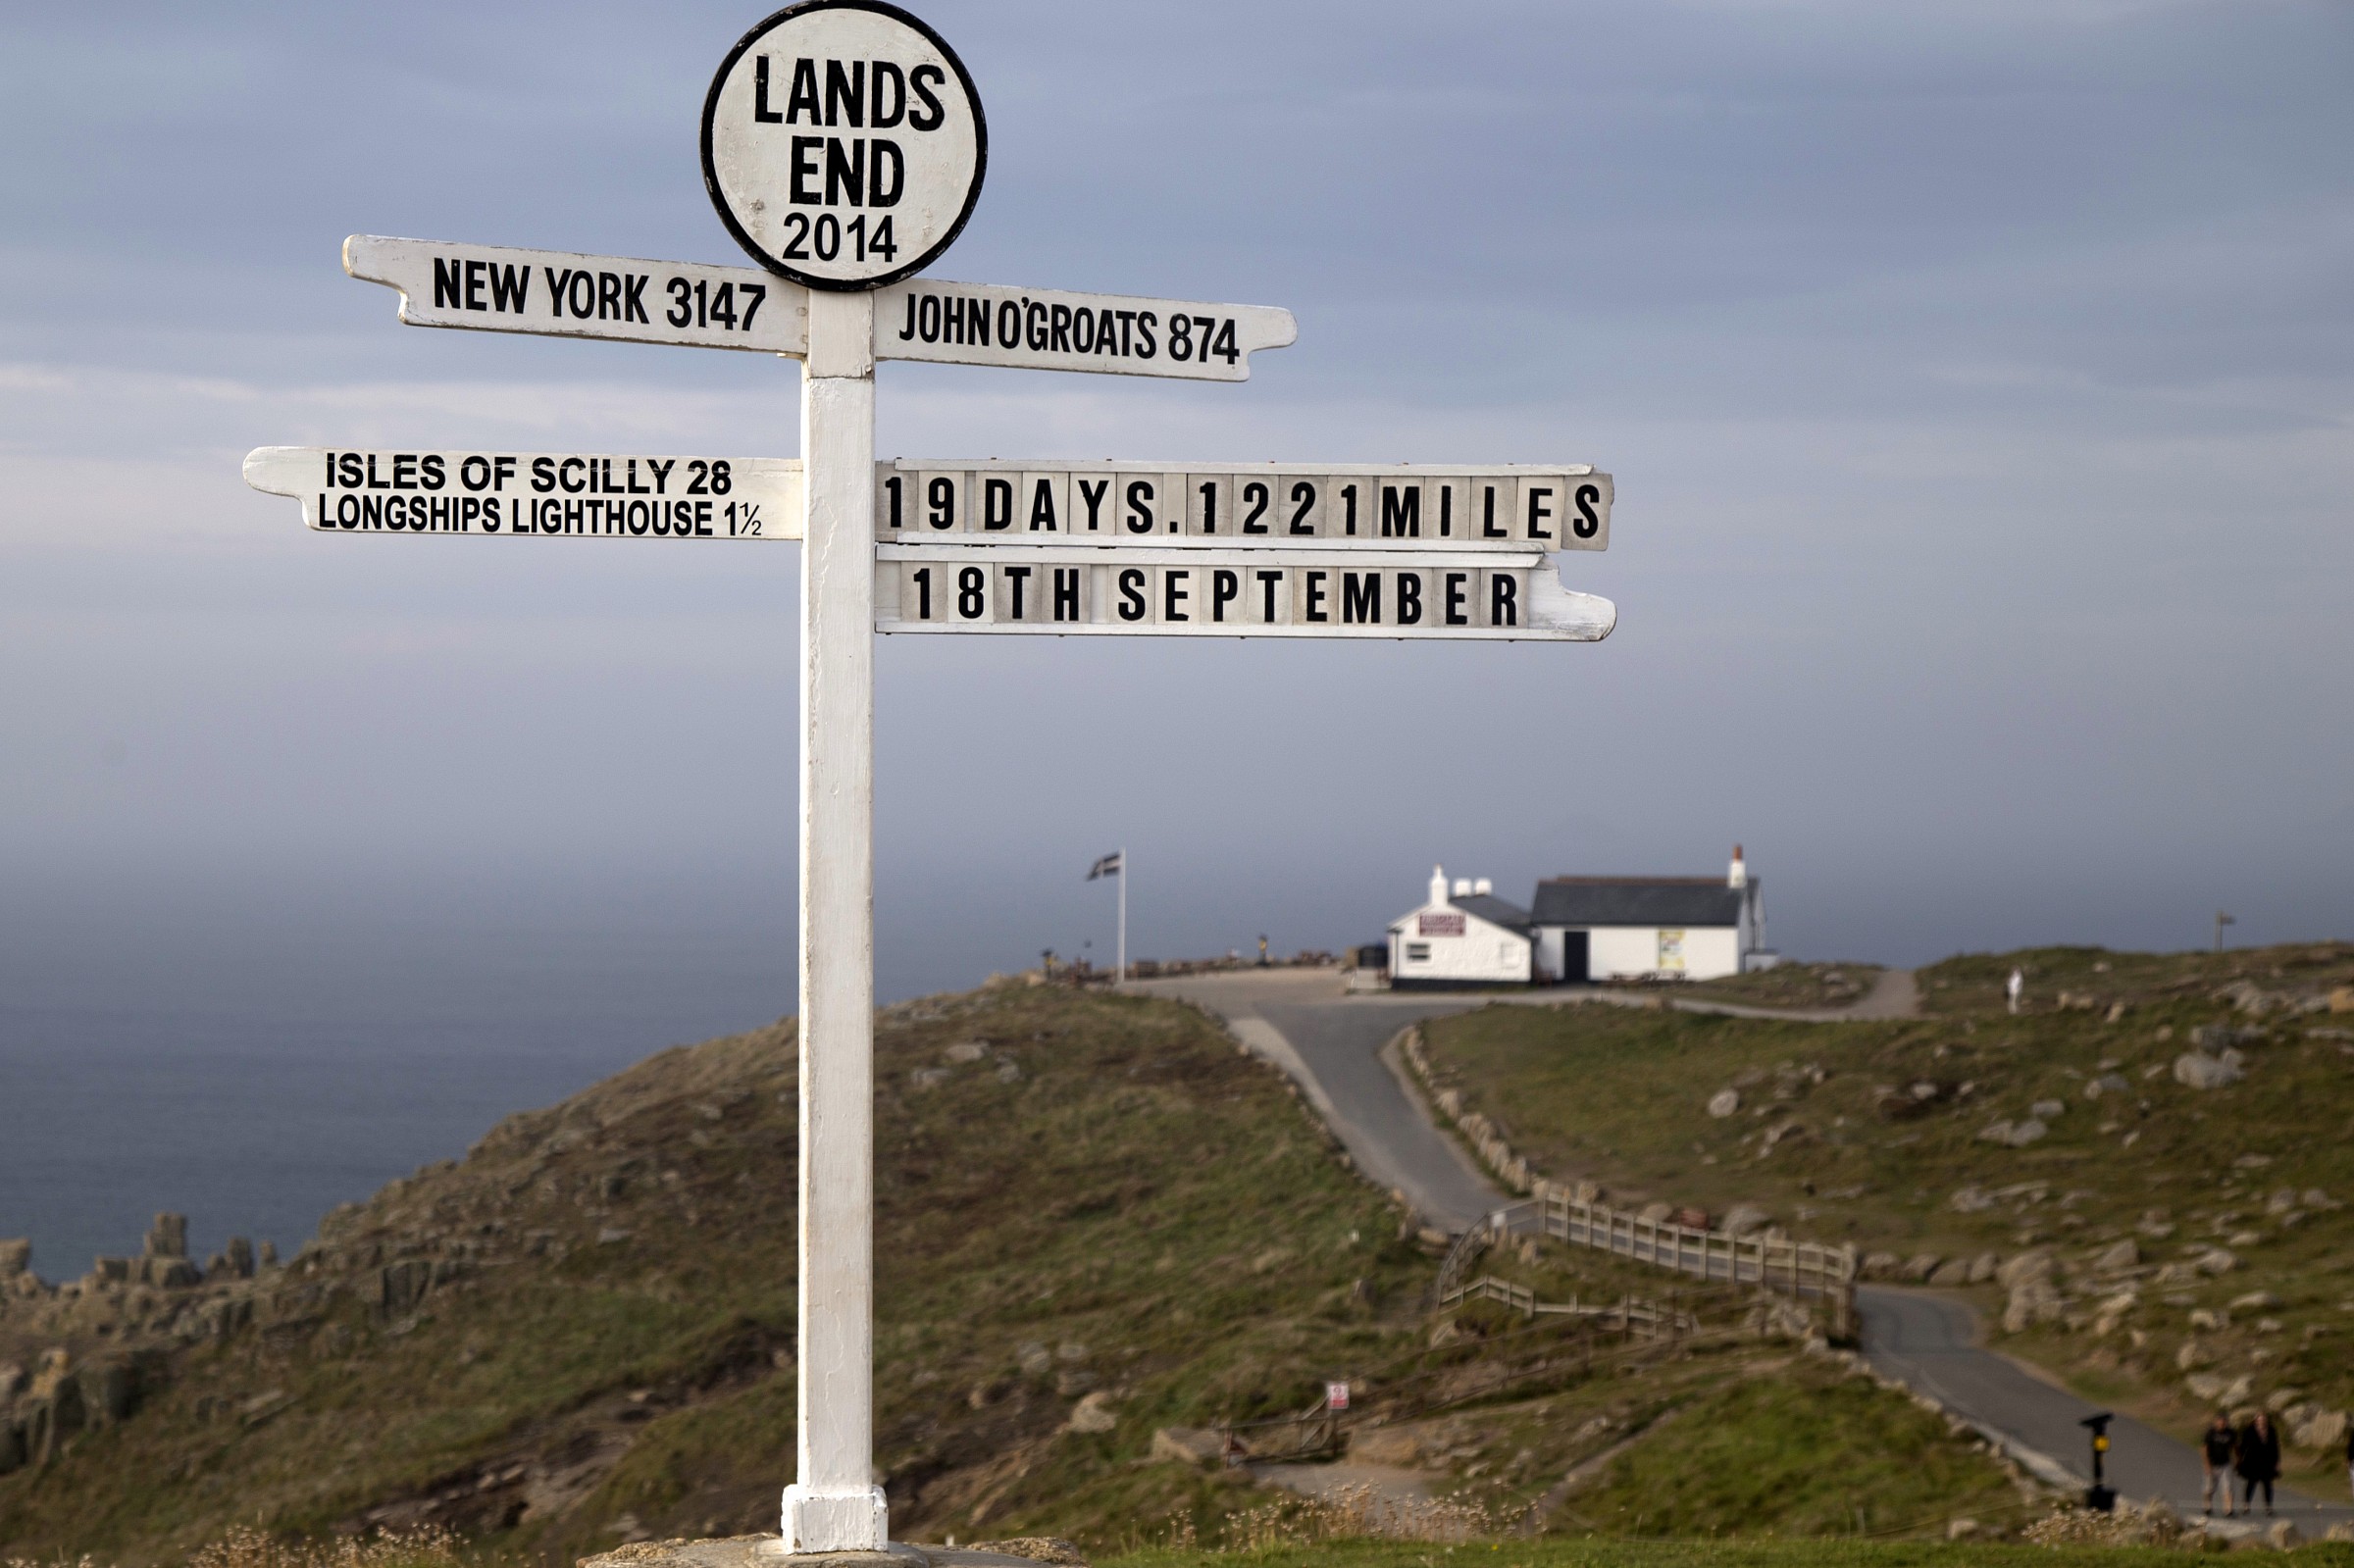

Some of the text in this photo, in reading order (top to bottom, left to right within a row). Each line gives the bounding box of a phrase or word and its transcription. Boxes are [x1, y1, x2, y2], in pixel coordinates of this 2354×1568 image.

[754, 55, 947, 132] LANDS
[789, 135, 905, 208] END
[782, 212, 897, 263] 2014
[434, 257, 766, 331] NEW YORK 3147
[898, 292, 1241, 365] JOHN O'GROATS 874
[327, 452, 732, 496] ISLES OF SCILLY 28
[885, 476, 954, 531] 19
[319, 493, 501, 533] LONGSHIPS
[512, 498, 713, 536] LIGHTHOUSE
[913, 566, 1517, 627] 18TH SEPTEMBER
